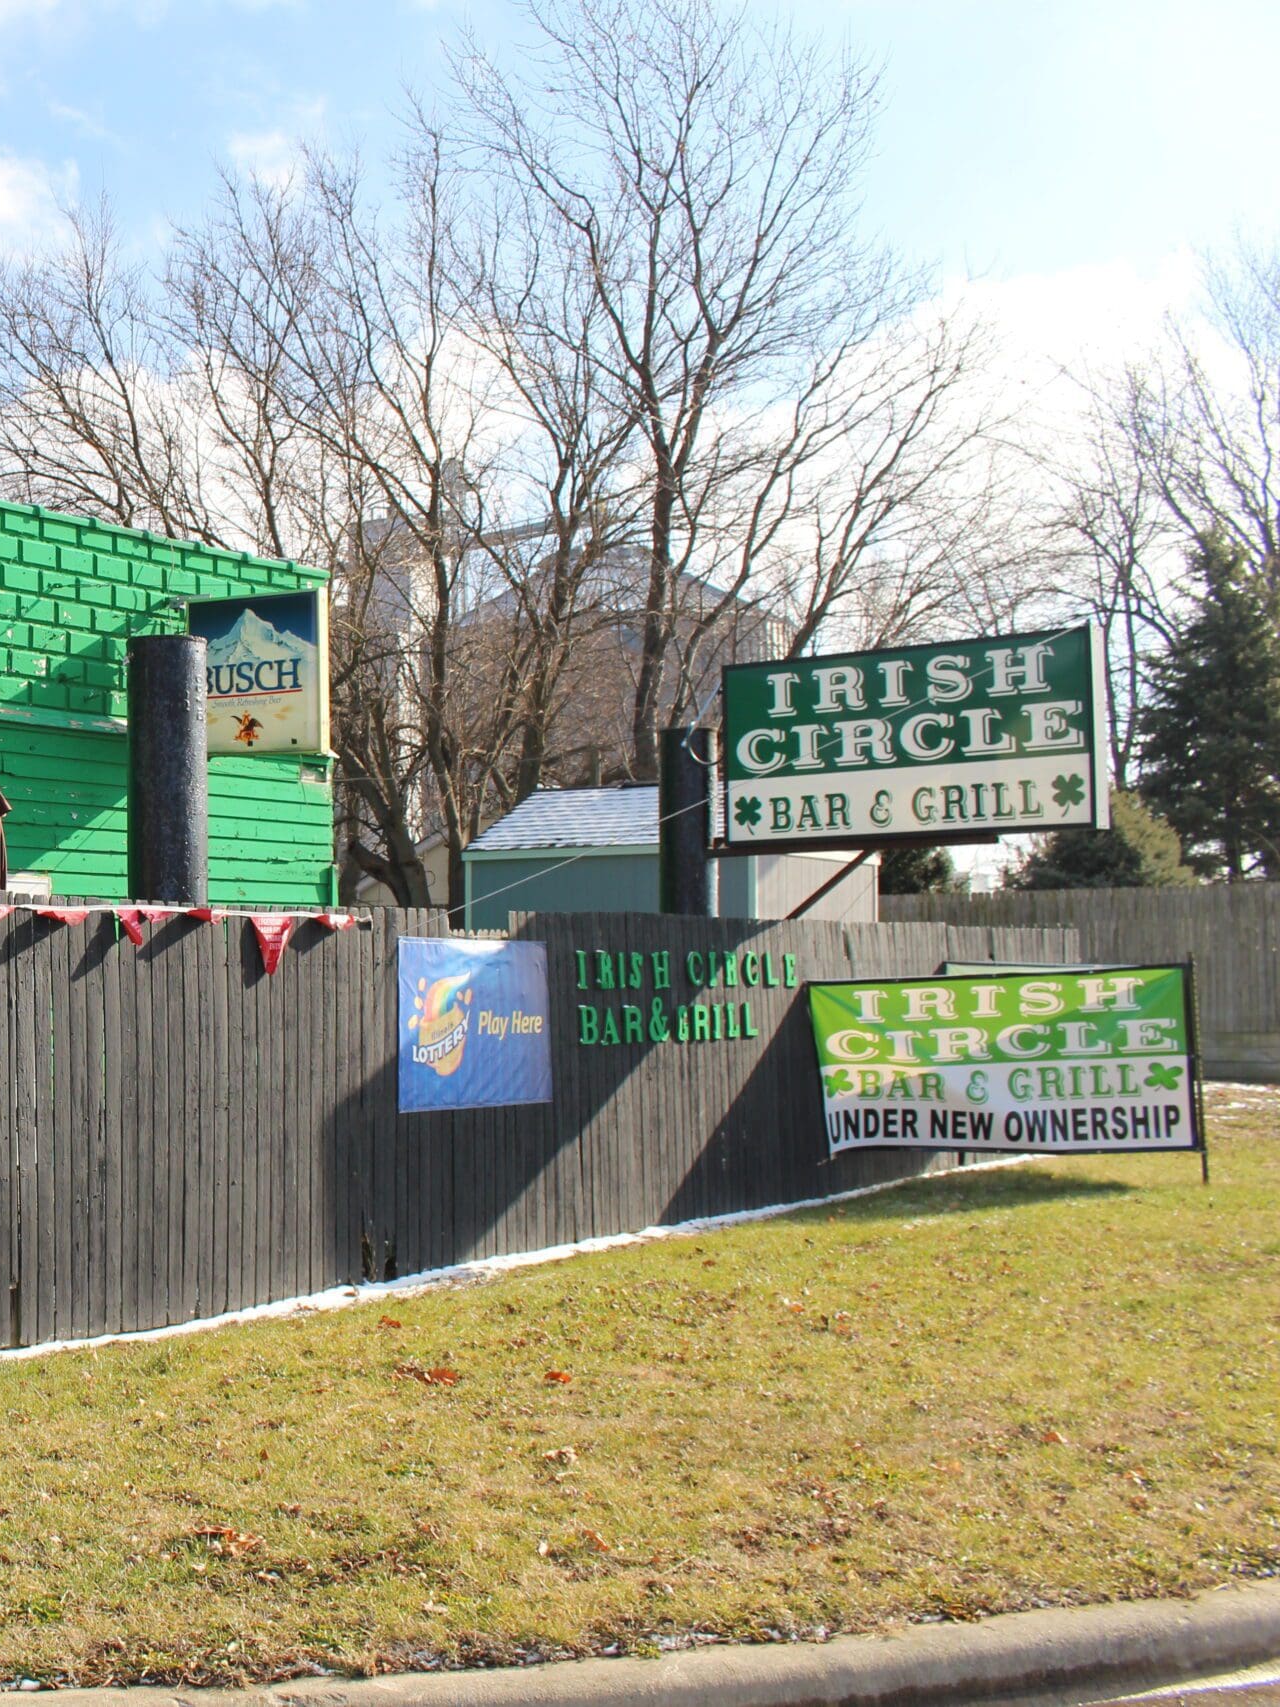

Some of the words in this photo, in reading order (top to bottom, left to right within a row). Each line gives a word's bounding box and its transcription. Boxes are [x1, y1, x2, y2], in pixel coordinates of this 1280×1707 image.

[766, 645, 1055, 718] IRISH
[736, 700, 1085, 774] CIRCLE
[769, 791, 851, 832] BAR
[869, 789, 893, 828] &
[911, 779, 1043, 824] GRILL
[576, 950, 670, 989] IRISH
[687, 951, 798, 988] CIRCLE
[578, 1004, 643, 1045] BAR
[649, 997, 669, 1042] &
[677, 1002, 758, 1041] GRILL
[852, 977, 1145, 1023] IRISH
[412, 1009, 471, 1063] LOTTERY
[478, 1010, 508, 1040] Play
[511, 1011, 543, 1034] Here
[826, 1018, 1179, 1063] CIRCLE
[857, 1069, 946, 1101] BAR
[966, 1069, 988, 1104] &
[1008, 1063, 1141, 1101] GRILL
[828, 1107, 919, 1144] UNDER
[930, 1108, 994, 1140] NEW
[1004, 1104, 1180, 1143] OWNERSHIP
